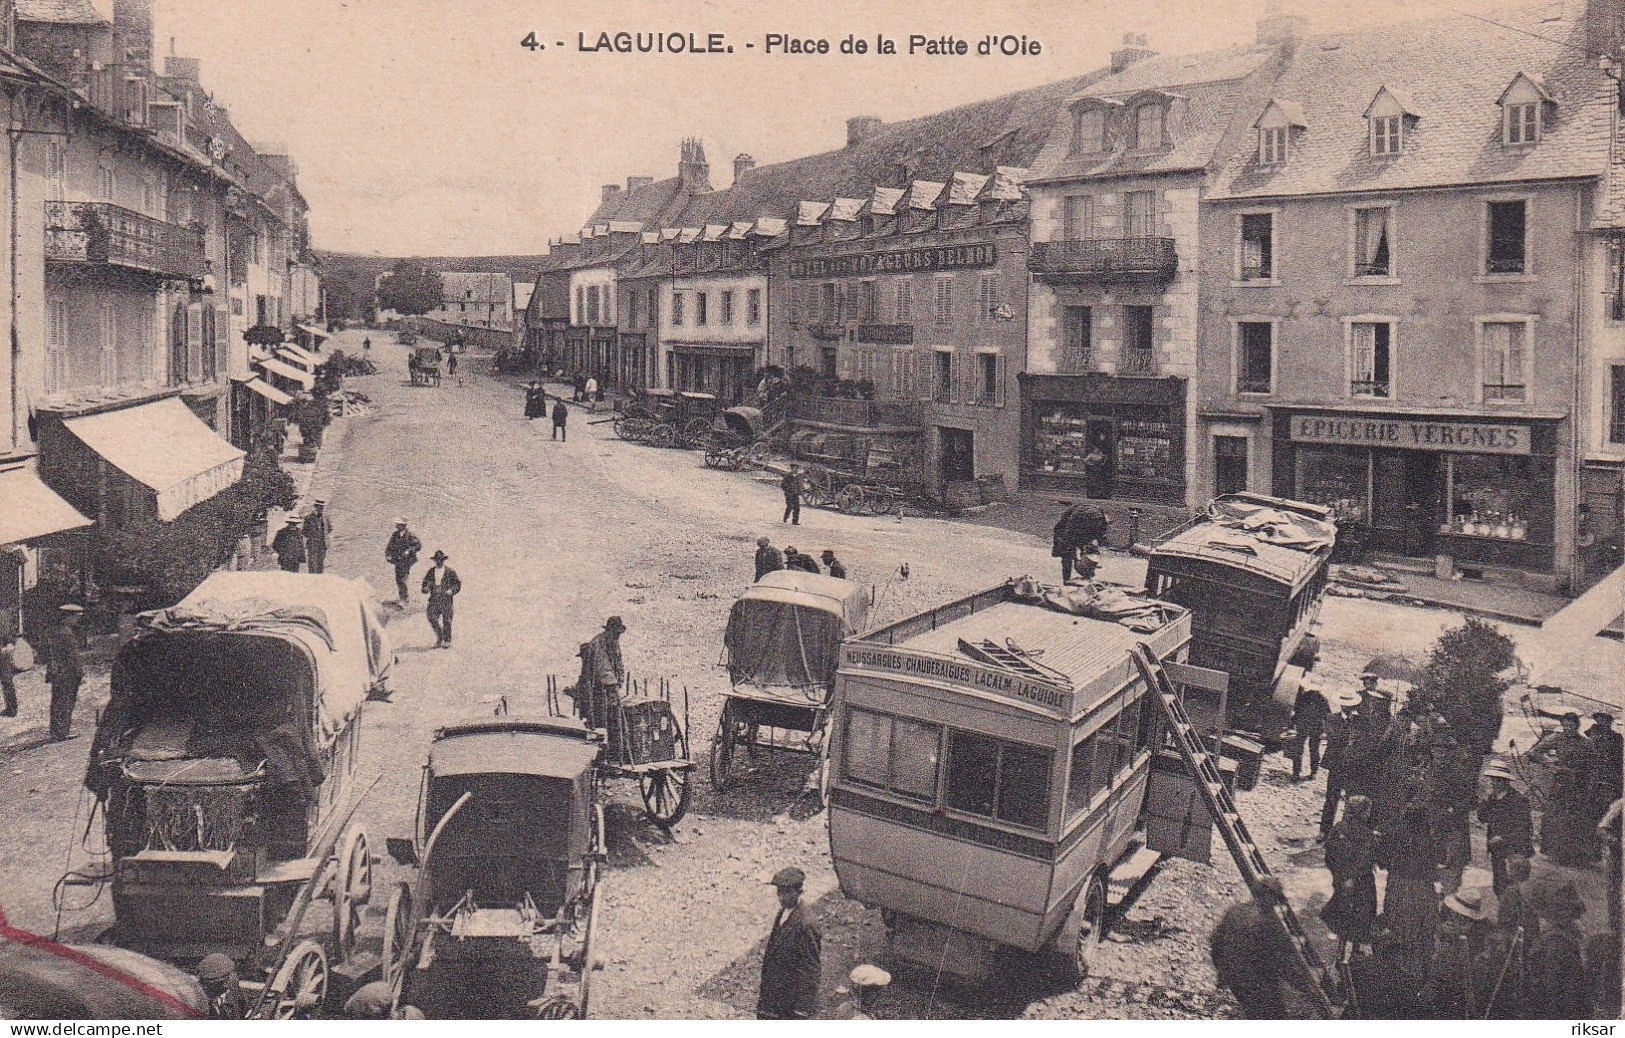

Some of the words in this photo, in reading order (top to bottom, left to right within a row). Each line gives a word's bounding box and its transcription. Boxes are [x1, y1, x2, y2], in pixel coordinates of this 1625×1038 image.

[1410, 424, 1519, 448] VERGNES
[846, 650, 901, 670] NEUSSARGUES
[906, 657, 970, 682] CHAUDESAIGUES
[974, 672, 1012, 692] LACALM
[1017, 683, 1065, 708] LAGUIOLE
